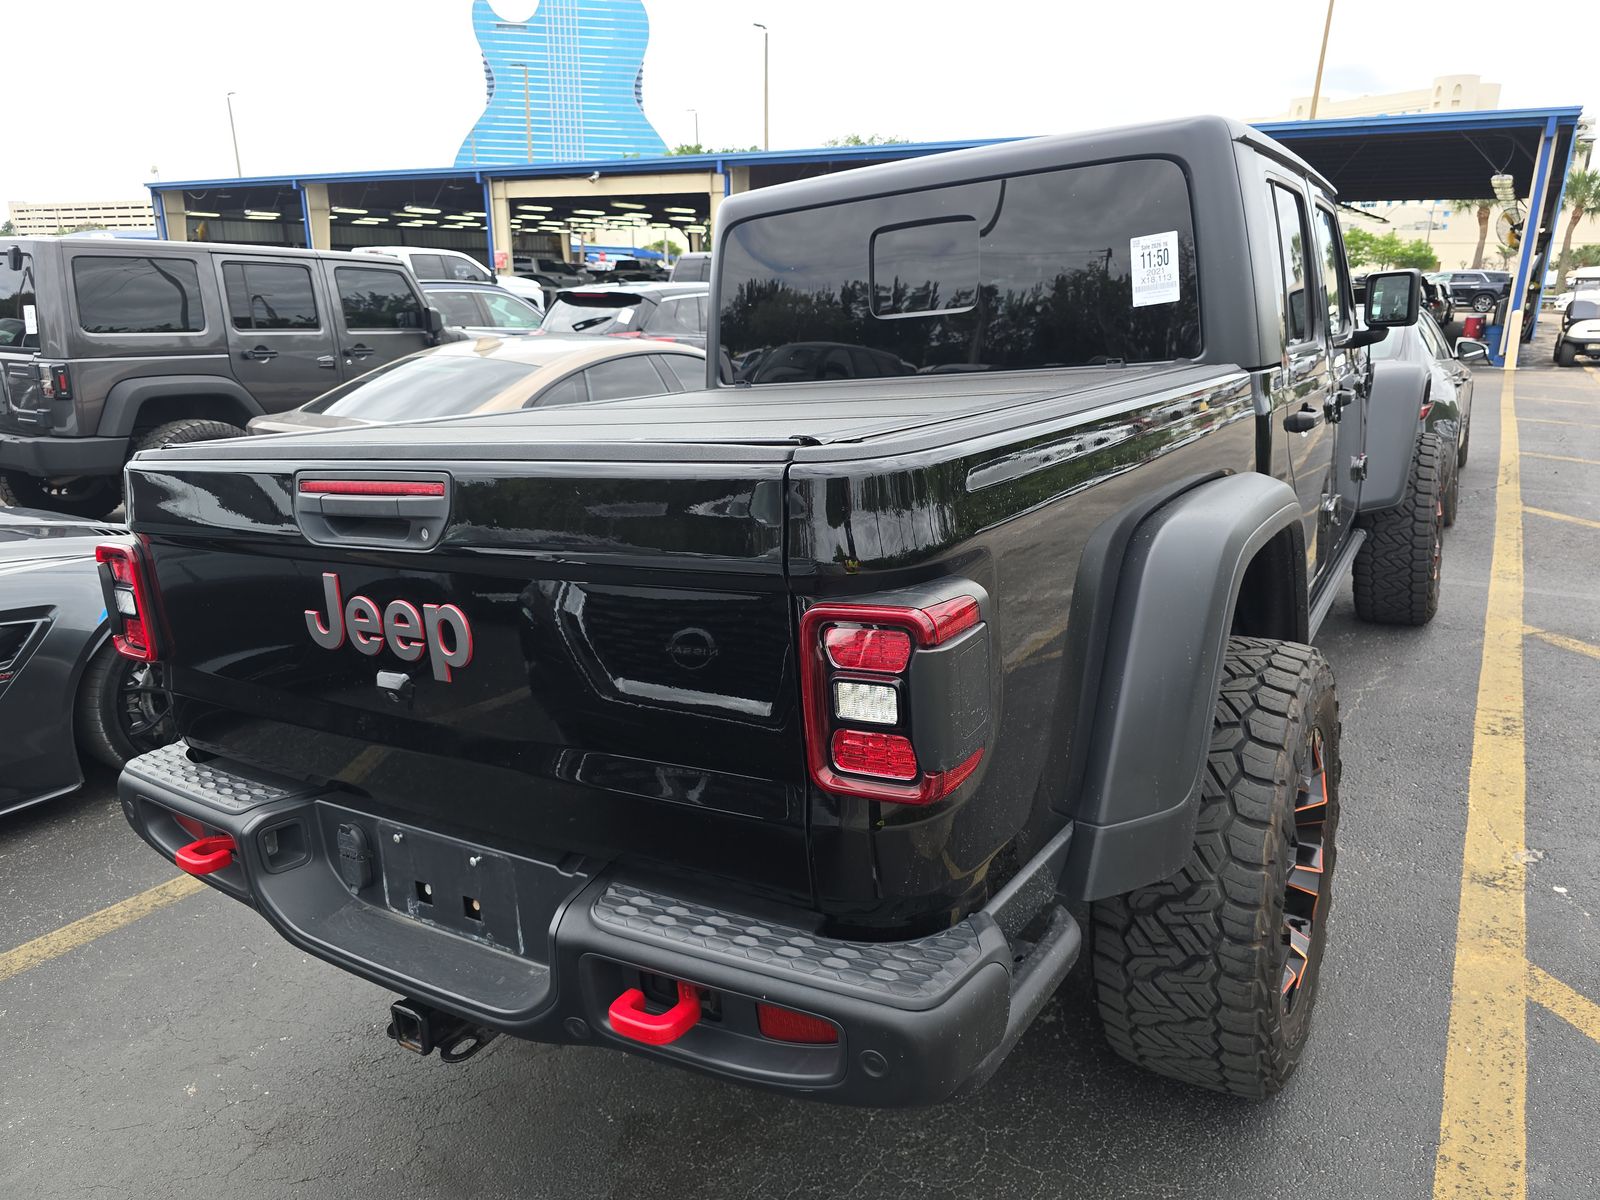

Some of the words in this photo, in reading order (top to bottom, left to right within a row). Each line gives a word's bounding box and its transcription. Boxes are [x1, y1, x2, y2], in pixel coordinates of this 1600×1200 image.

[1140, 248, 1169, 269] 11:50
[1146, 267, 1165, 277] 2021
[304, 572, 473, 682] Jeep
